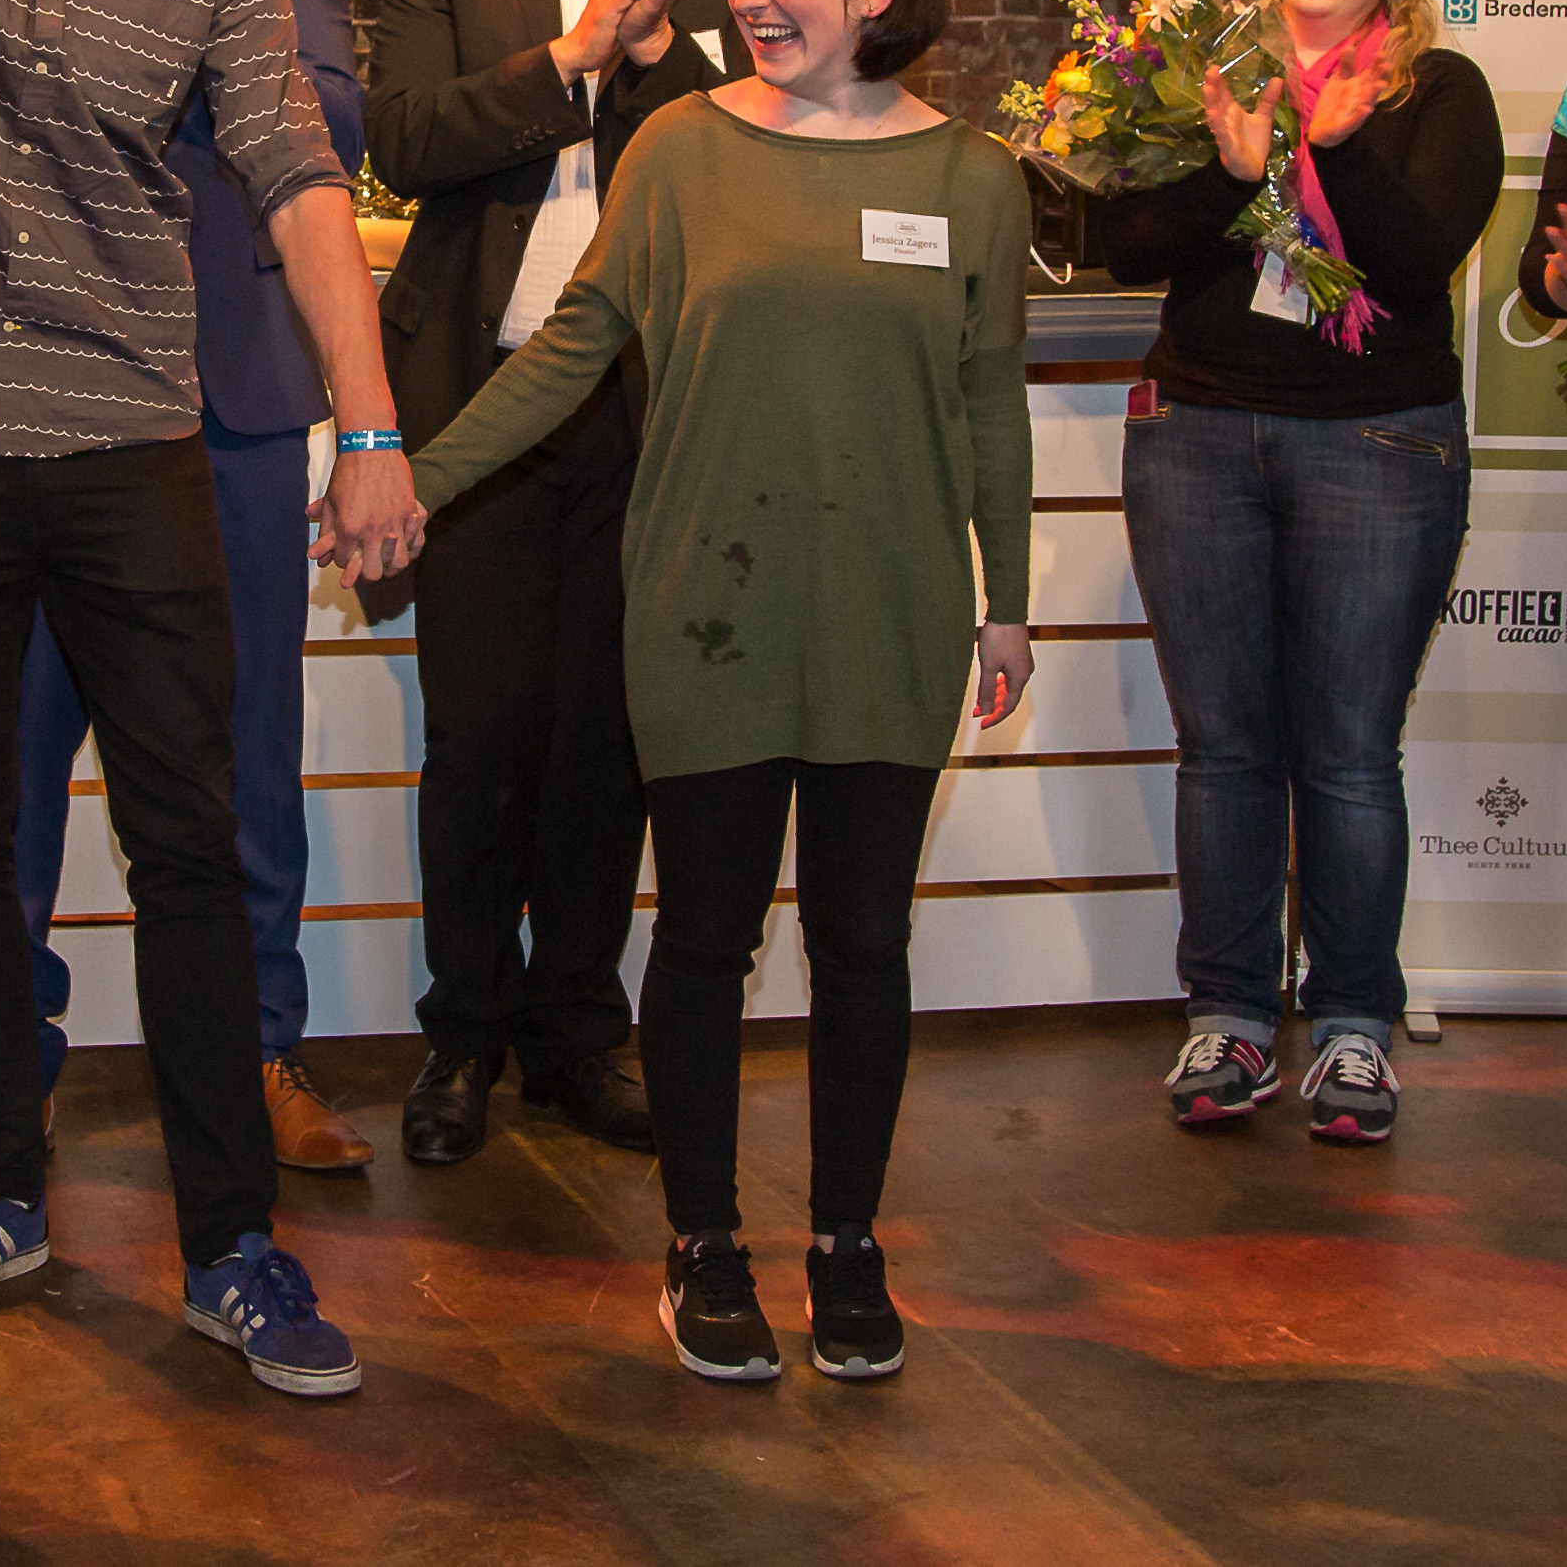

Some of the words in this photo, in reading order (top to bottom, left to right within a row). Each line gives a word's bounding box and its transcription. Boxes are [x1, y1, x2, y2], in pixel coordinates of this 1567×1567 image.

[872, 233, 904, 246] Jessica
[906, 237, 939, 250] Zagers
[1497, 627, 1563, 644] cacao
[1420, 836, 1478, 855] Thee
